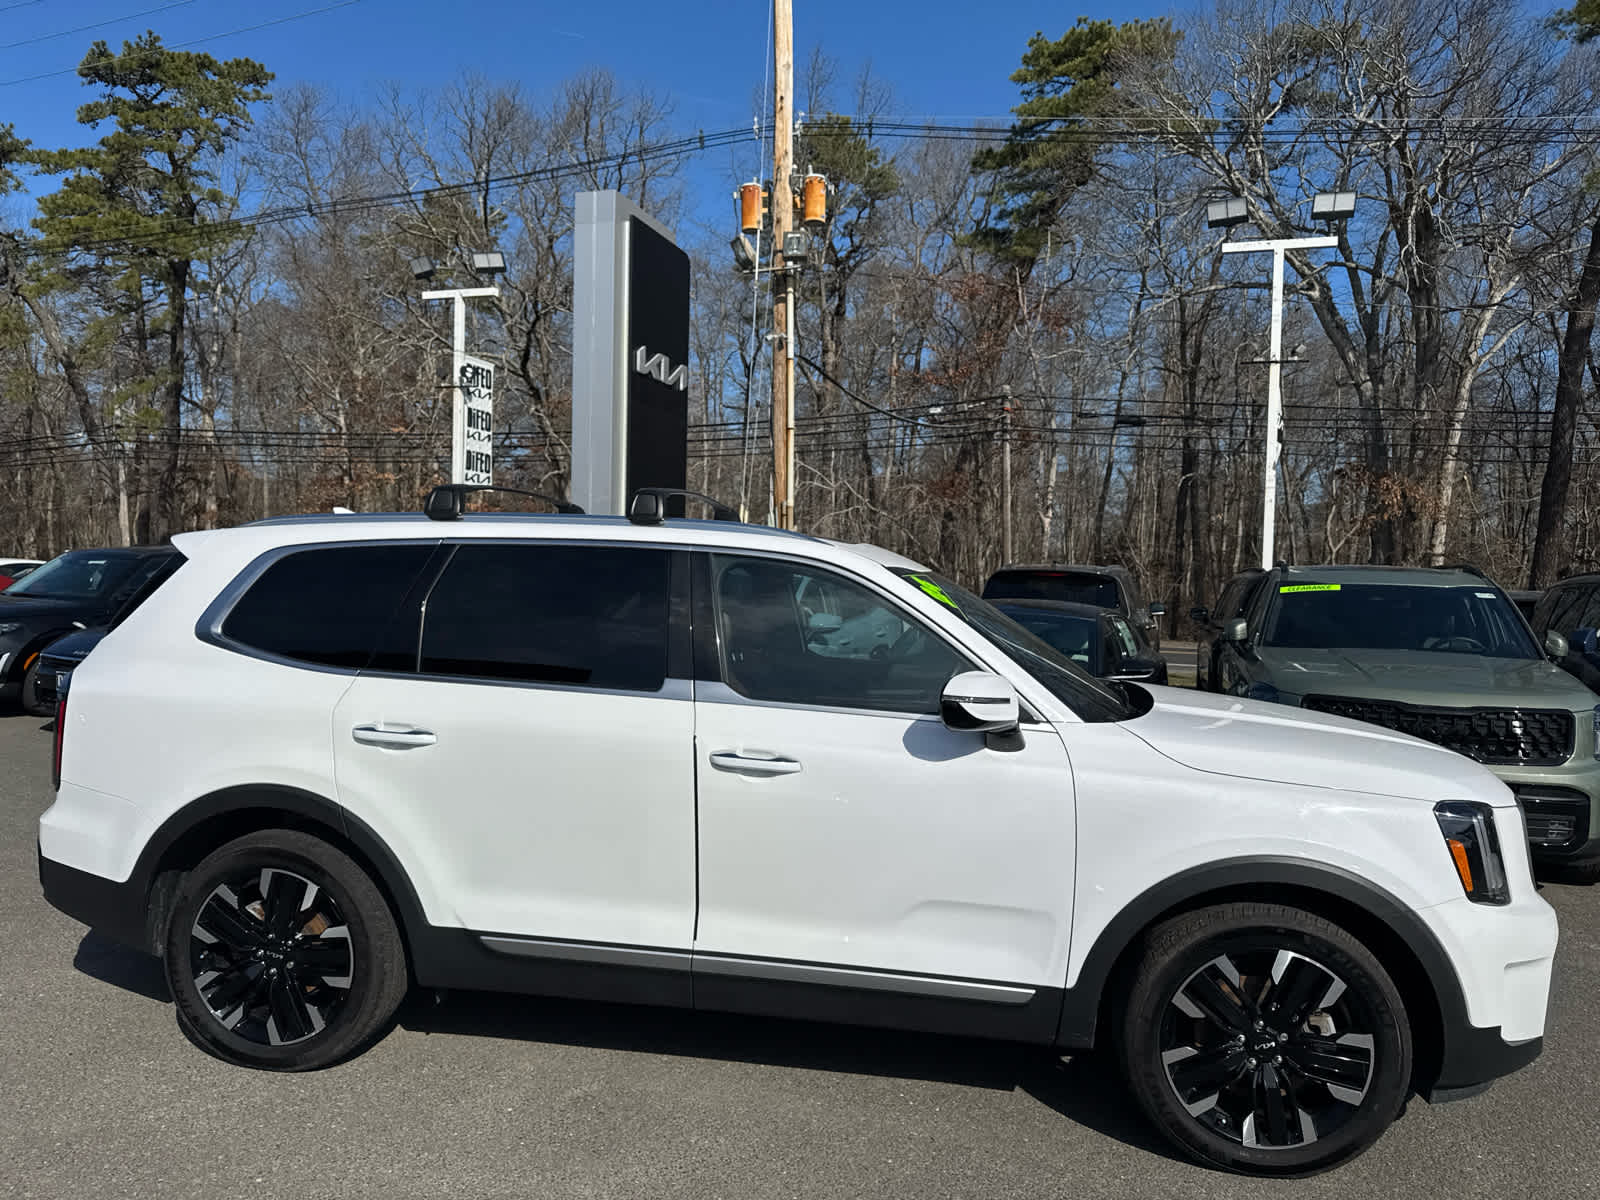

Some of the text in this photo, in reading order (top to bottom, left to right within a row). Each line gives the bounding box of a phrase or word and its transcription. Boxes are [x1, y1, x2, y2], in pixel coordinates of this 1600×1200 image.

[636, 345, 688, 391] KIA
[467, 430, 491, 442] KIA
[465, 472, 490, 483] KIA
